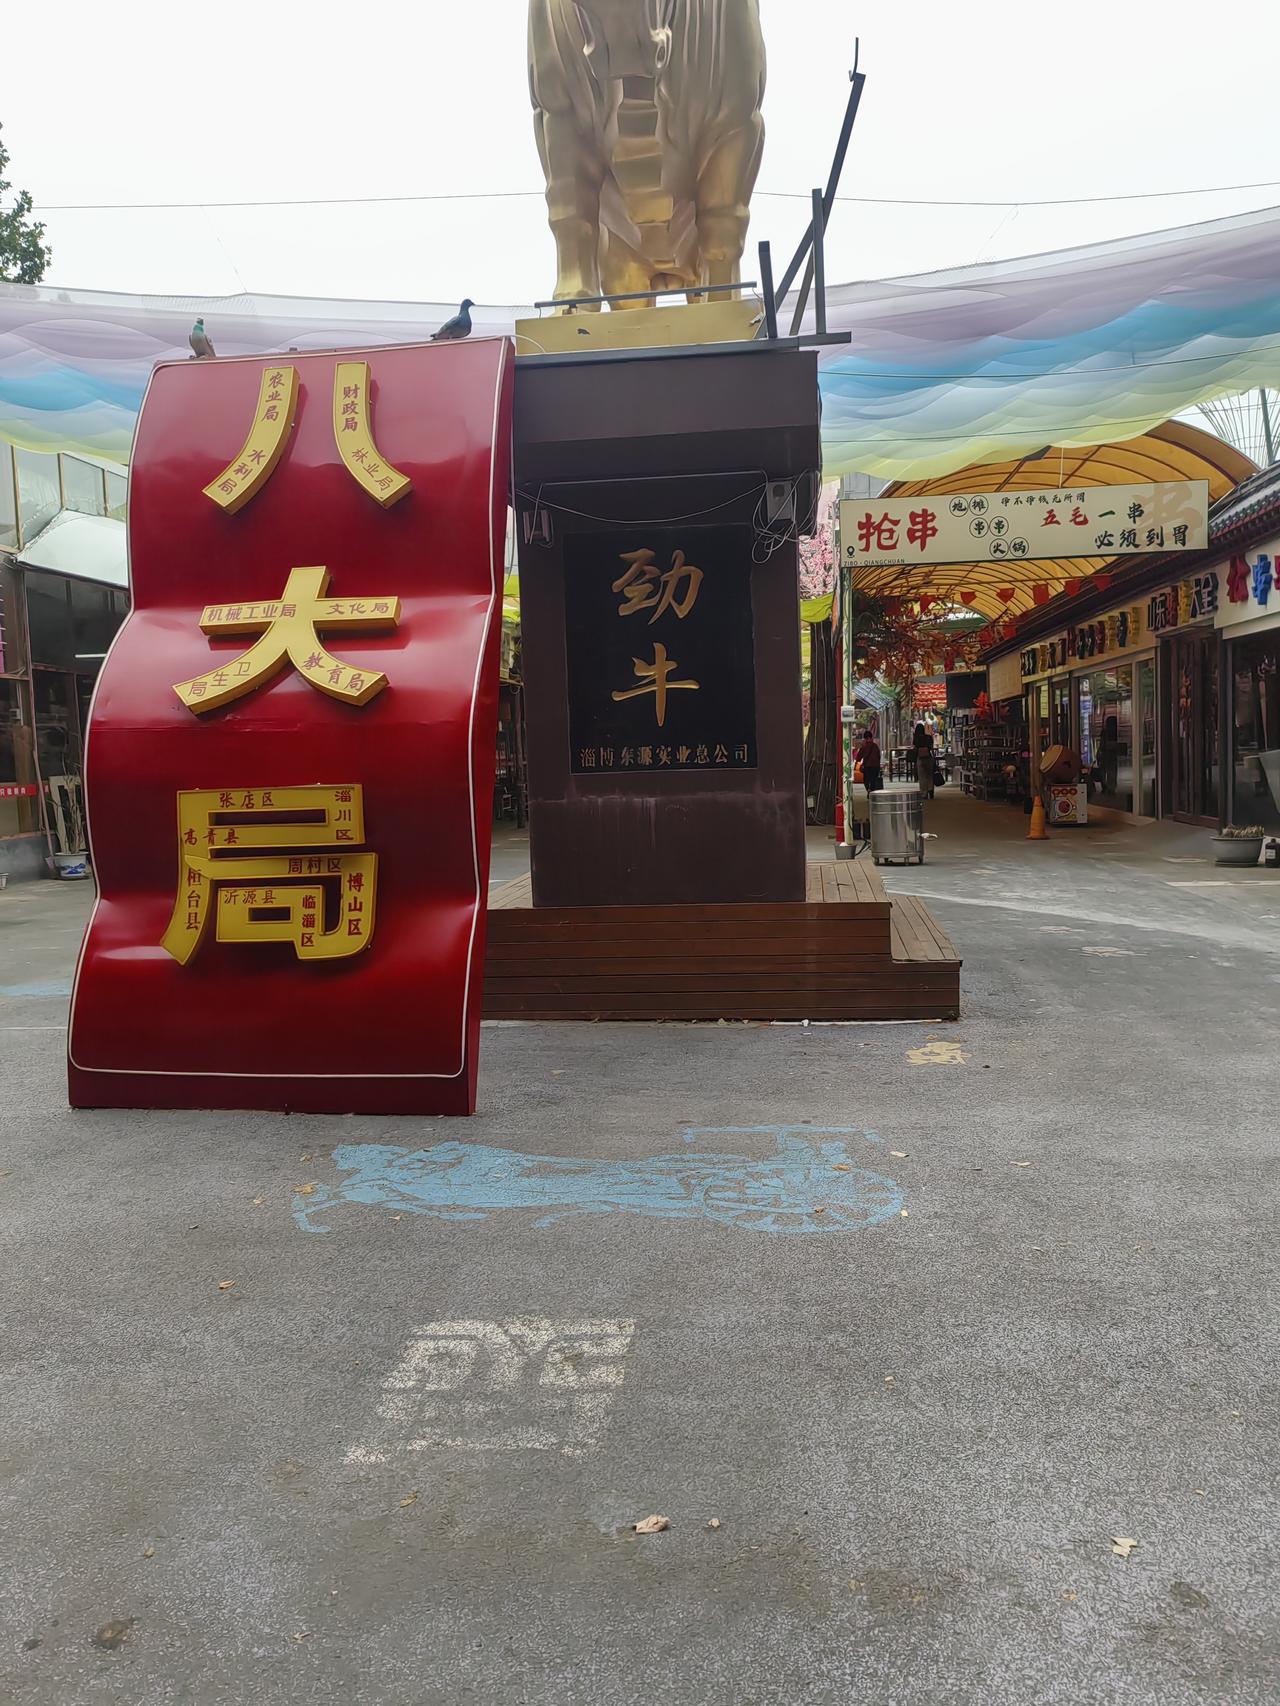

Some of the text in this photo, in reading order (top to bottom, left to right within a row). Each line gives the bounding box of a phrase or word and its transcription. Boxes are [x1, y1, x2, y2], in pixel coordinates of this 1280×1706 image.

[261, 371, 285, 422] 农业局
[341, 384, 361, 432] 财政局
[217, 449, 266, 496] 水利局
[351, 447, 394, 492] 林业局
[950, 497, 987, 515] 地摊
[1040, 501, 1145, 527] 五毛一串
[857, 508, 938, 552] 抢串
[971, 518, 1007, 536] 串串
[1094, 524, 1189, 549] 必须到胃
[991, 539, 1027, 556] 火锅
[207, 604, 296, 621] 机械工业局
[326, 602, 389, 615] 文化局
[611, 547, 704, 727] 劲牛
[302, 651, 366, 693] 教育局
[219, 791, 274, 808] 张店区
[334, 790, 353, 841] 淄川区
[184, 828, 240, 846] 高青县
[288, 857, 342, 874] 周村区
[224, 890, 276, 905] 沂源县
[347, 872, 364, 936] 博山区
[301, 895, 316, 947] 临淄区
